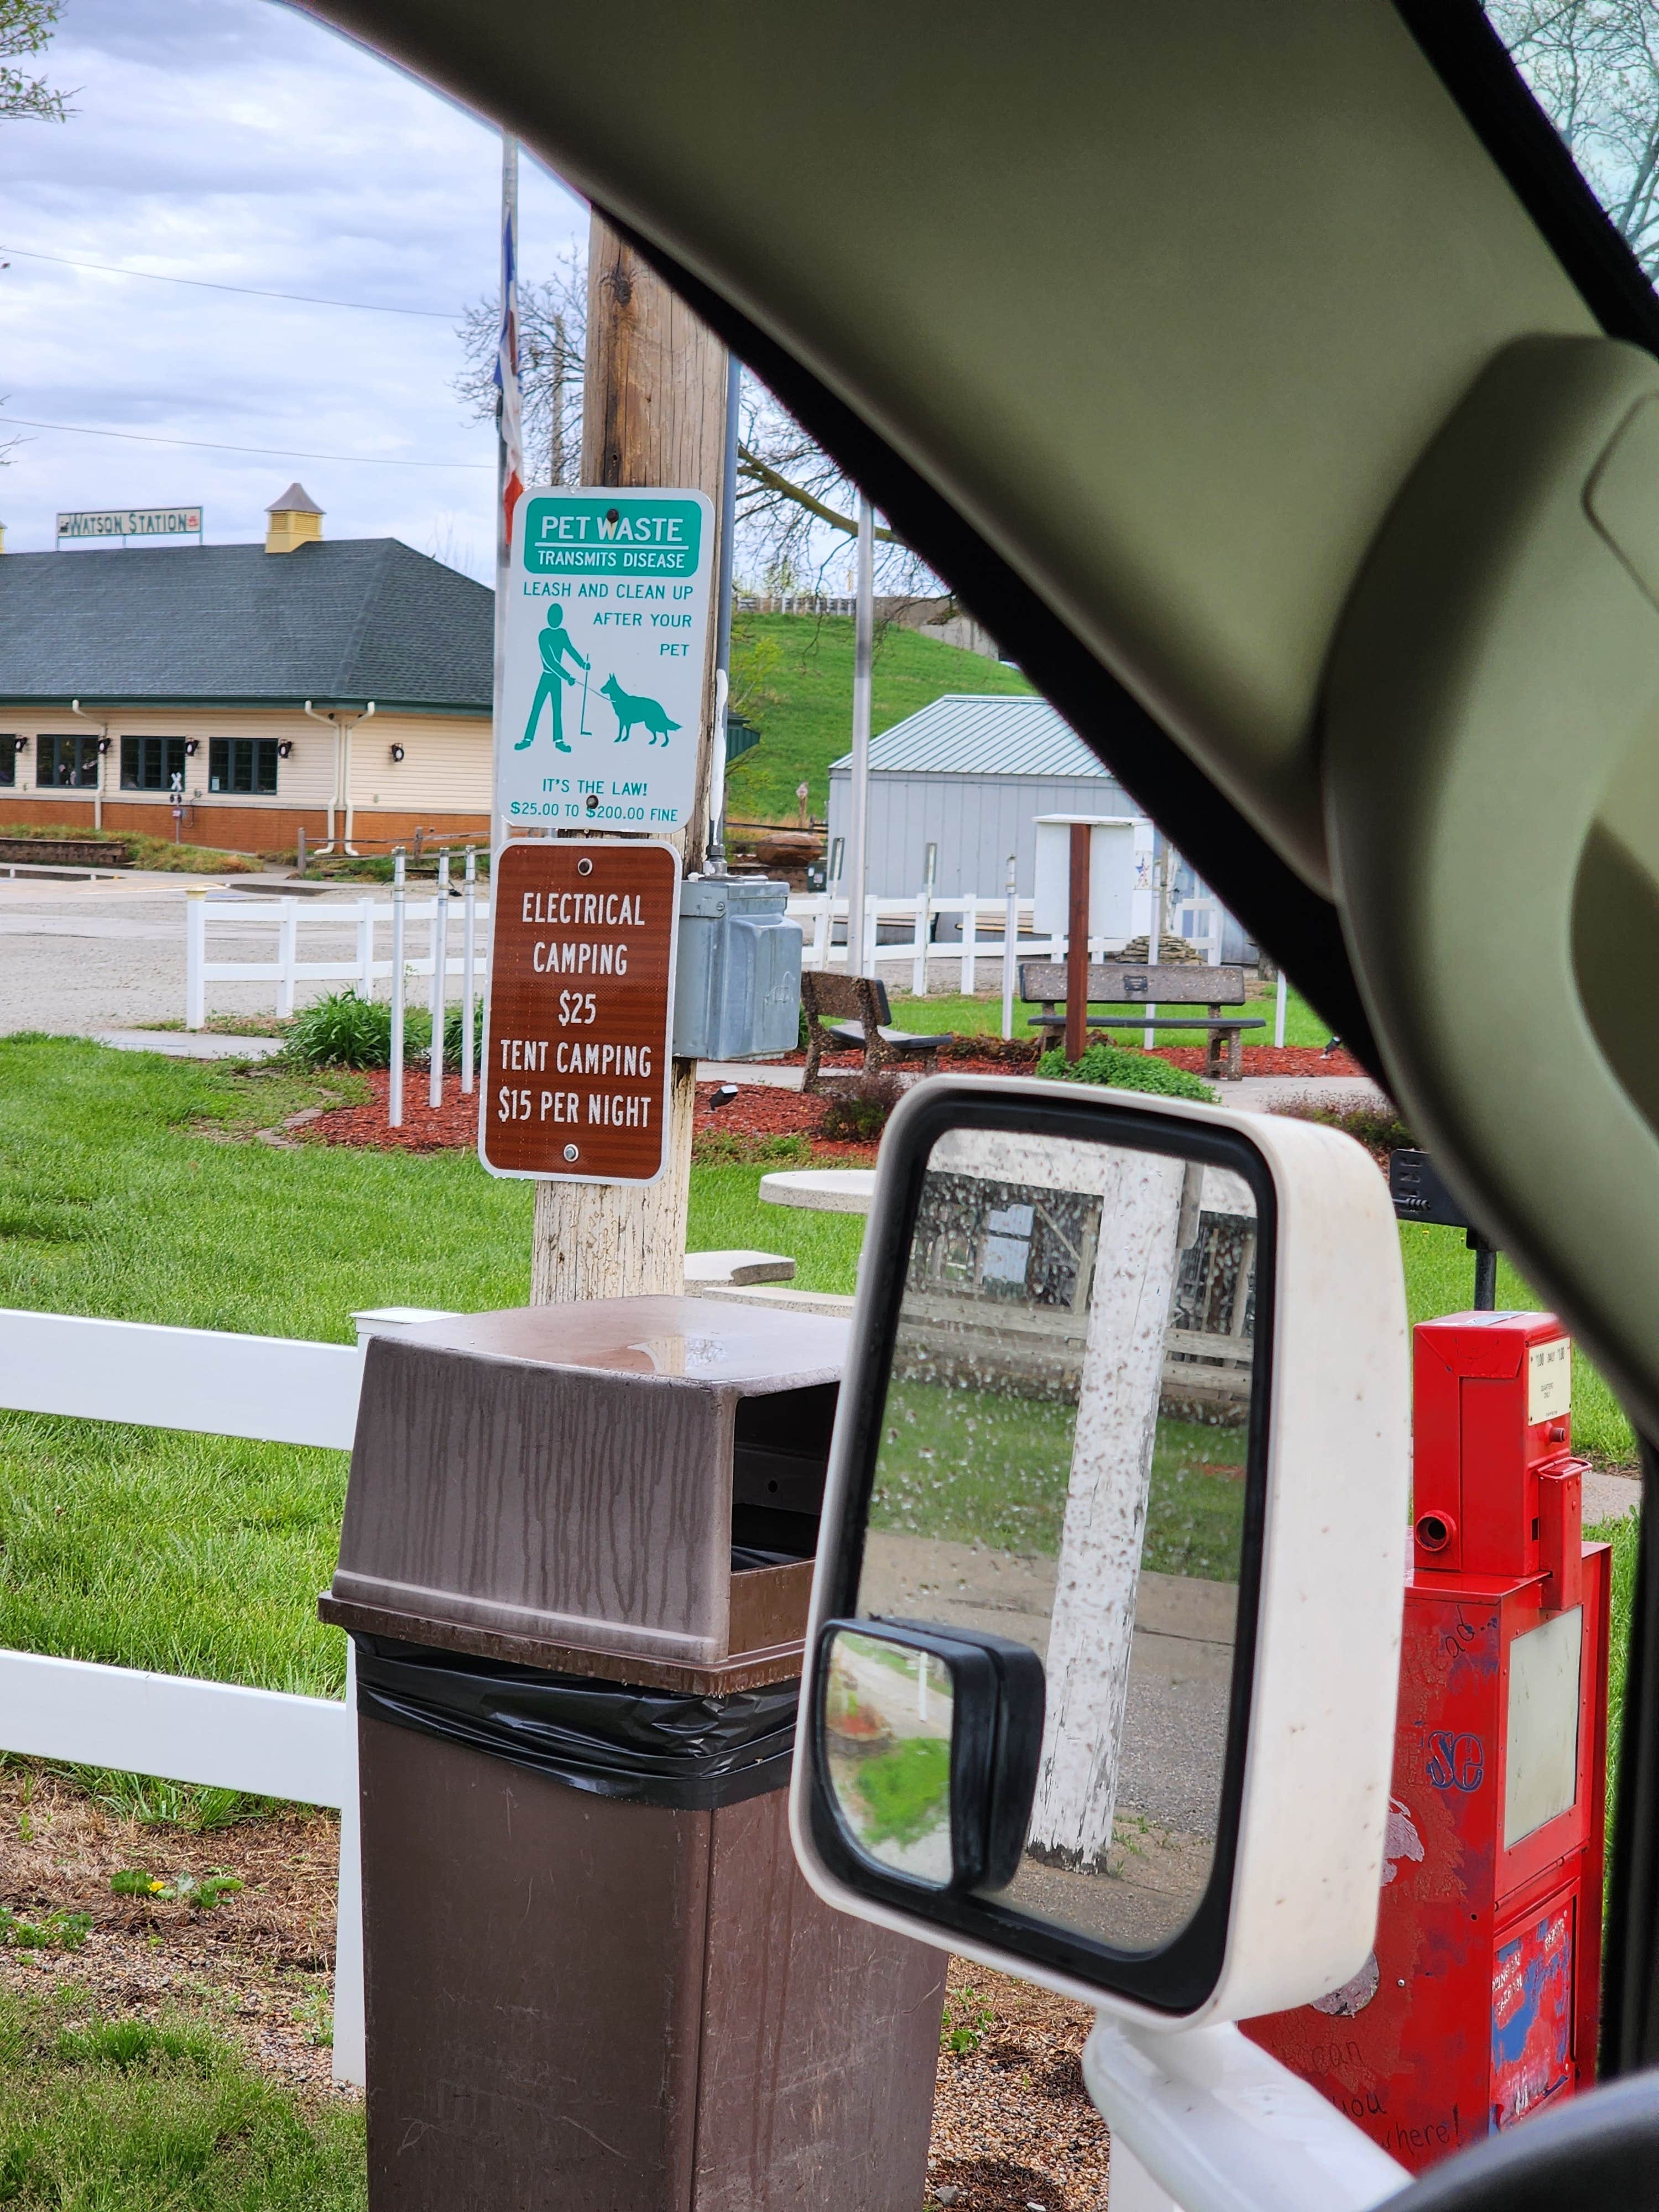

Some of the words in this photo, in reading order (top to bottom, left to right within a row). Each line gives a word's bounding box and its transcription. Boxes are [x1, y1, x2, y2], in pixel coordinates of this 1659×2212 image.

[541, 516, 591, 540] PET
[597, 517, 684, 542] WASTE
[538, 550, 617, 567] TRANSMITS
[623, 553, 685, 568] DISEASE
[524, 582, 571, 597] LEASH
[578, 584, 609, 598] AND
[616, 585, 666, 599] CLEAN
[672, 586, 693, 599] UP
[593, 613, 642, 627] AFTER
[650, 614, 692, 627] YOUR
[660, 644, 690, 656] PET
[542, 779, 570, 792] IT'S
[577, 780, 604, 794] THE
[612, 781, 648, 796] LAW!
[510, 802, 560, 816] $25.00
[565, 804, 579, 817] TO
[586, 805, 644, 820] $200.00
[650, 808, 678, 821] FINE
[523, 892, 645, 925] ELECTRICAL
[533, 942, 628, 975] CAMPING
[559, 990, 596, 1026] $25
[500, 1040, 549, 1071] TENT
[556, 1042, 651, 1078] CAMPING
[498, 1086, 531, 1122] $15
[541, 1091, 579, 1124] PER
[588, 1094, 651, 1128] NIGHT
